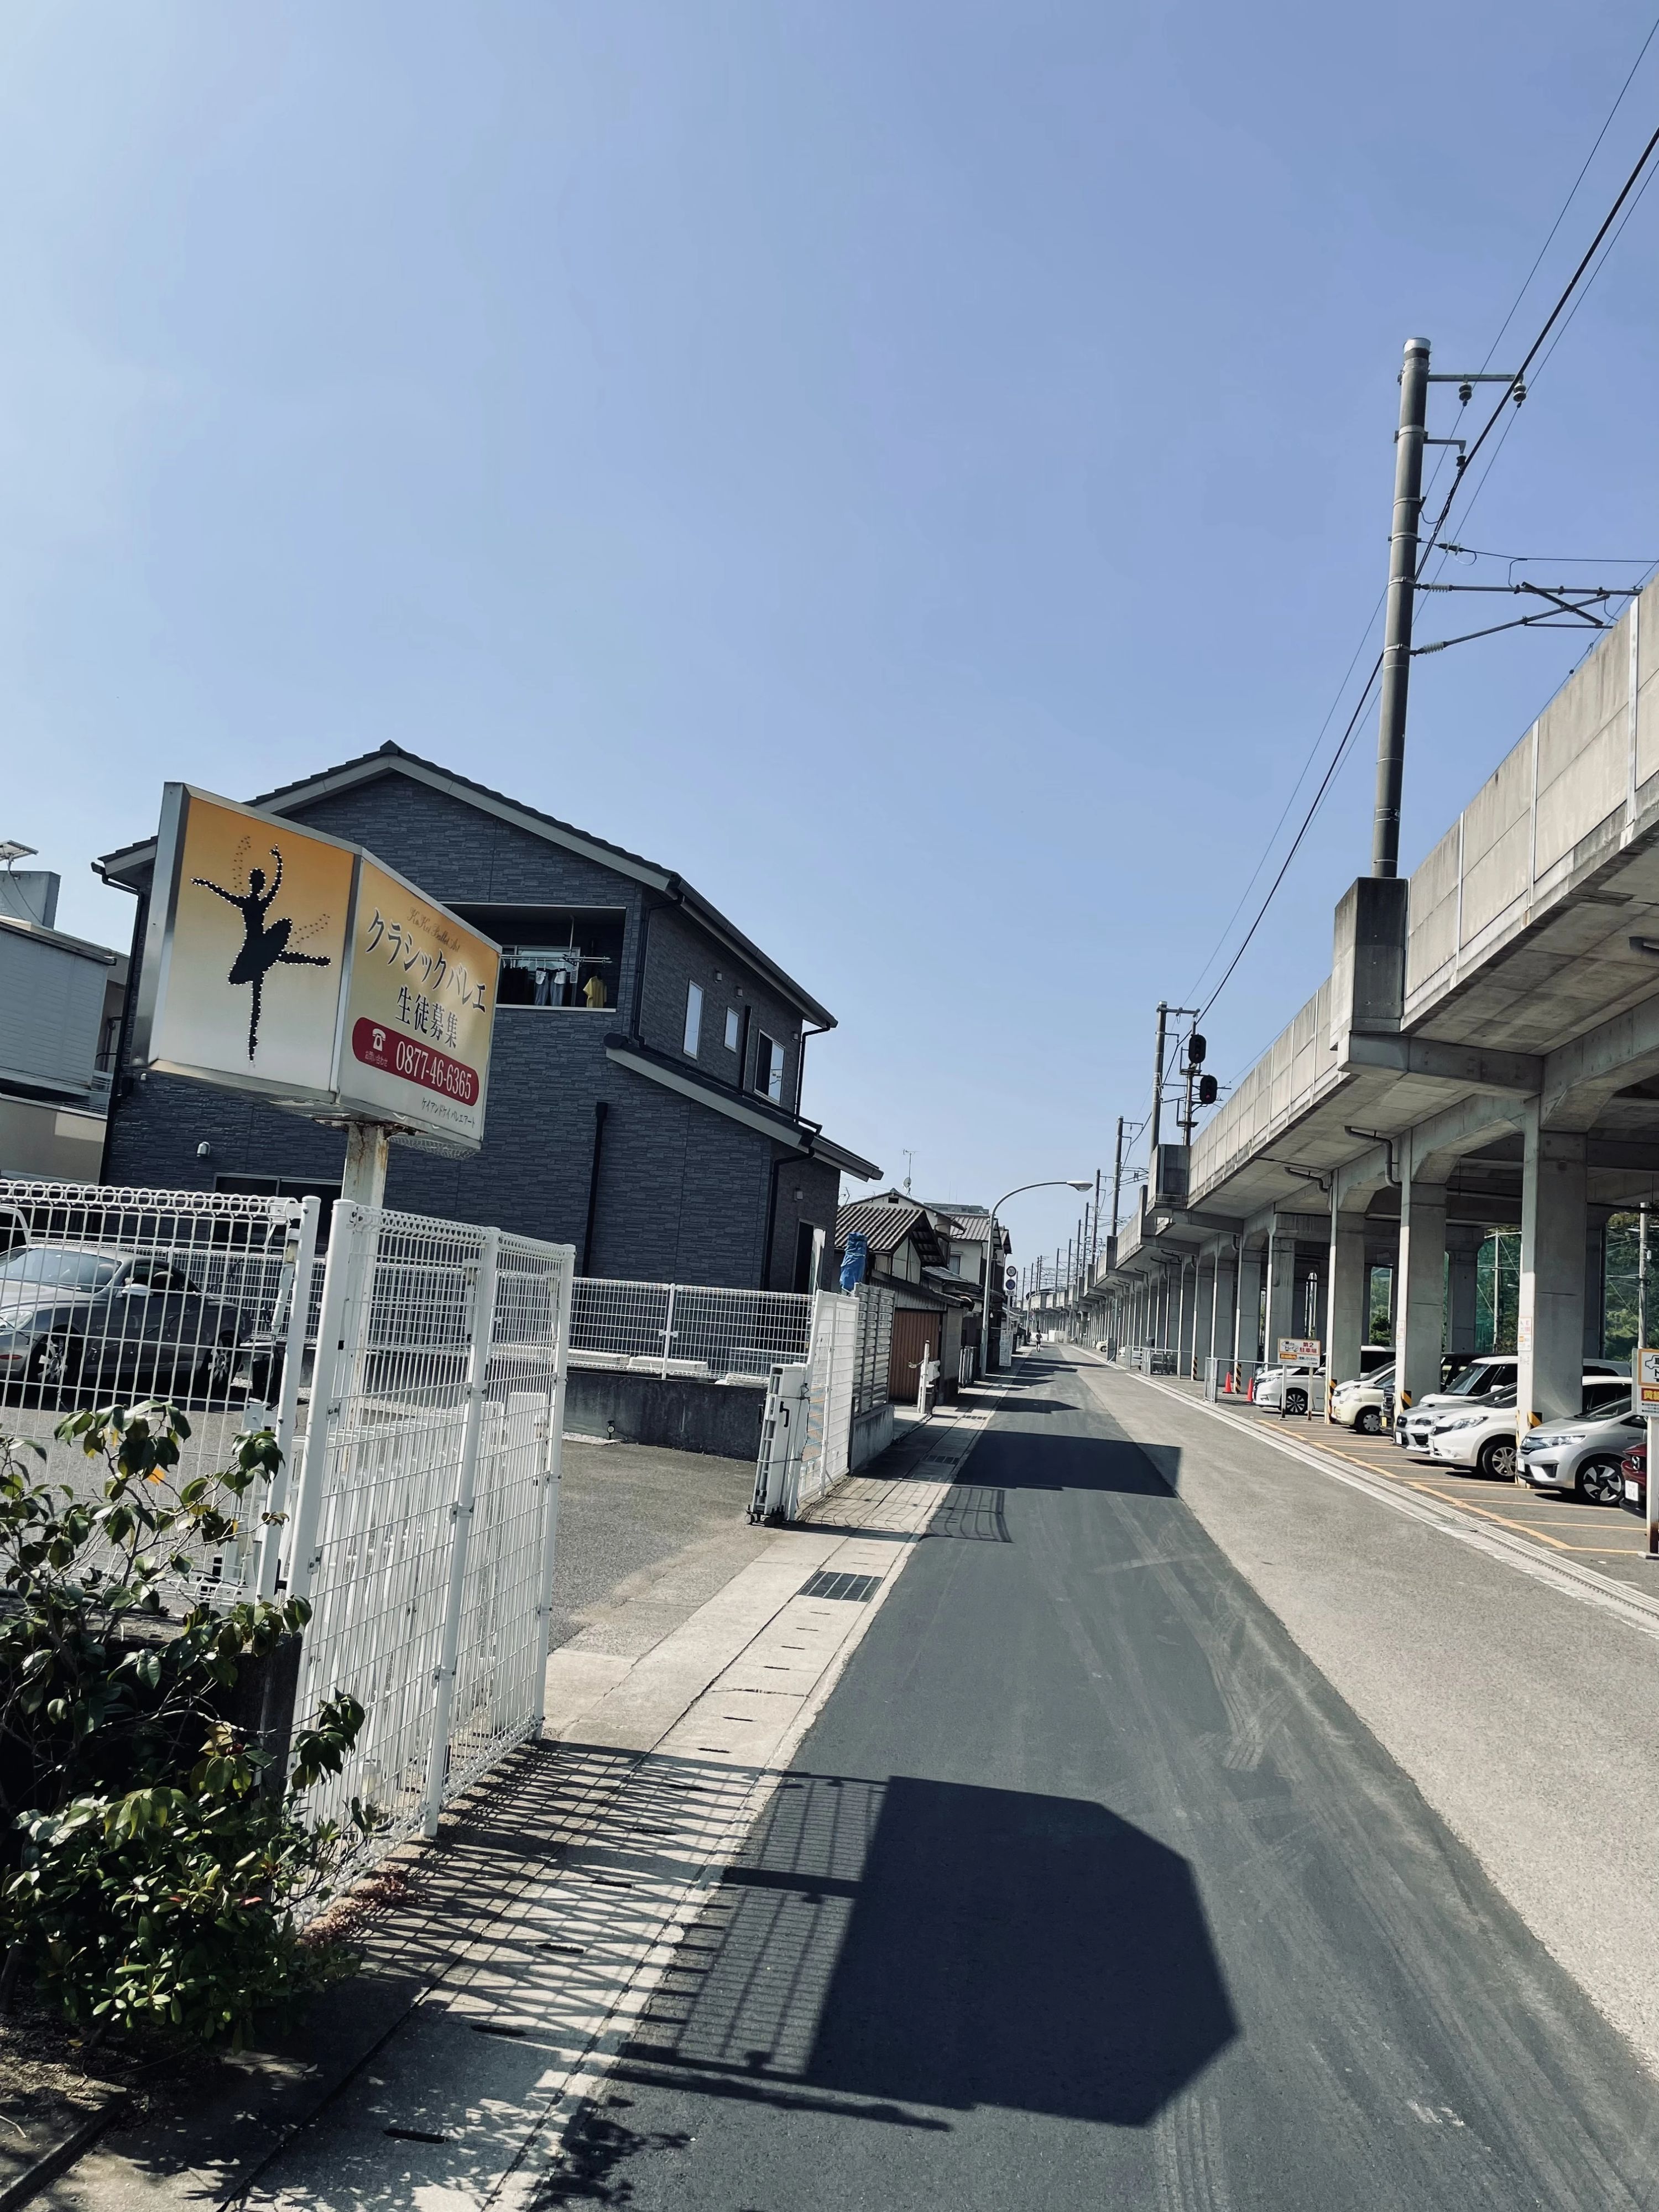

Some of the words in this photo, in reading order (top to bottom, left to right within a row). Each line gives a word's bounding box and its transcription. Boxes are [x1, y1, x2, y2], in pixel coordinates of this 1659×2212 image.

[366, 907, 486, 1013] クラシックバレエ
[395, 985, 458, 1049] 生徒募集
[396, 1041, 472, 1099] 0877-46-6365
